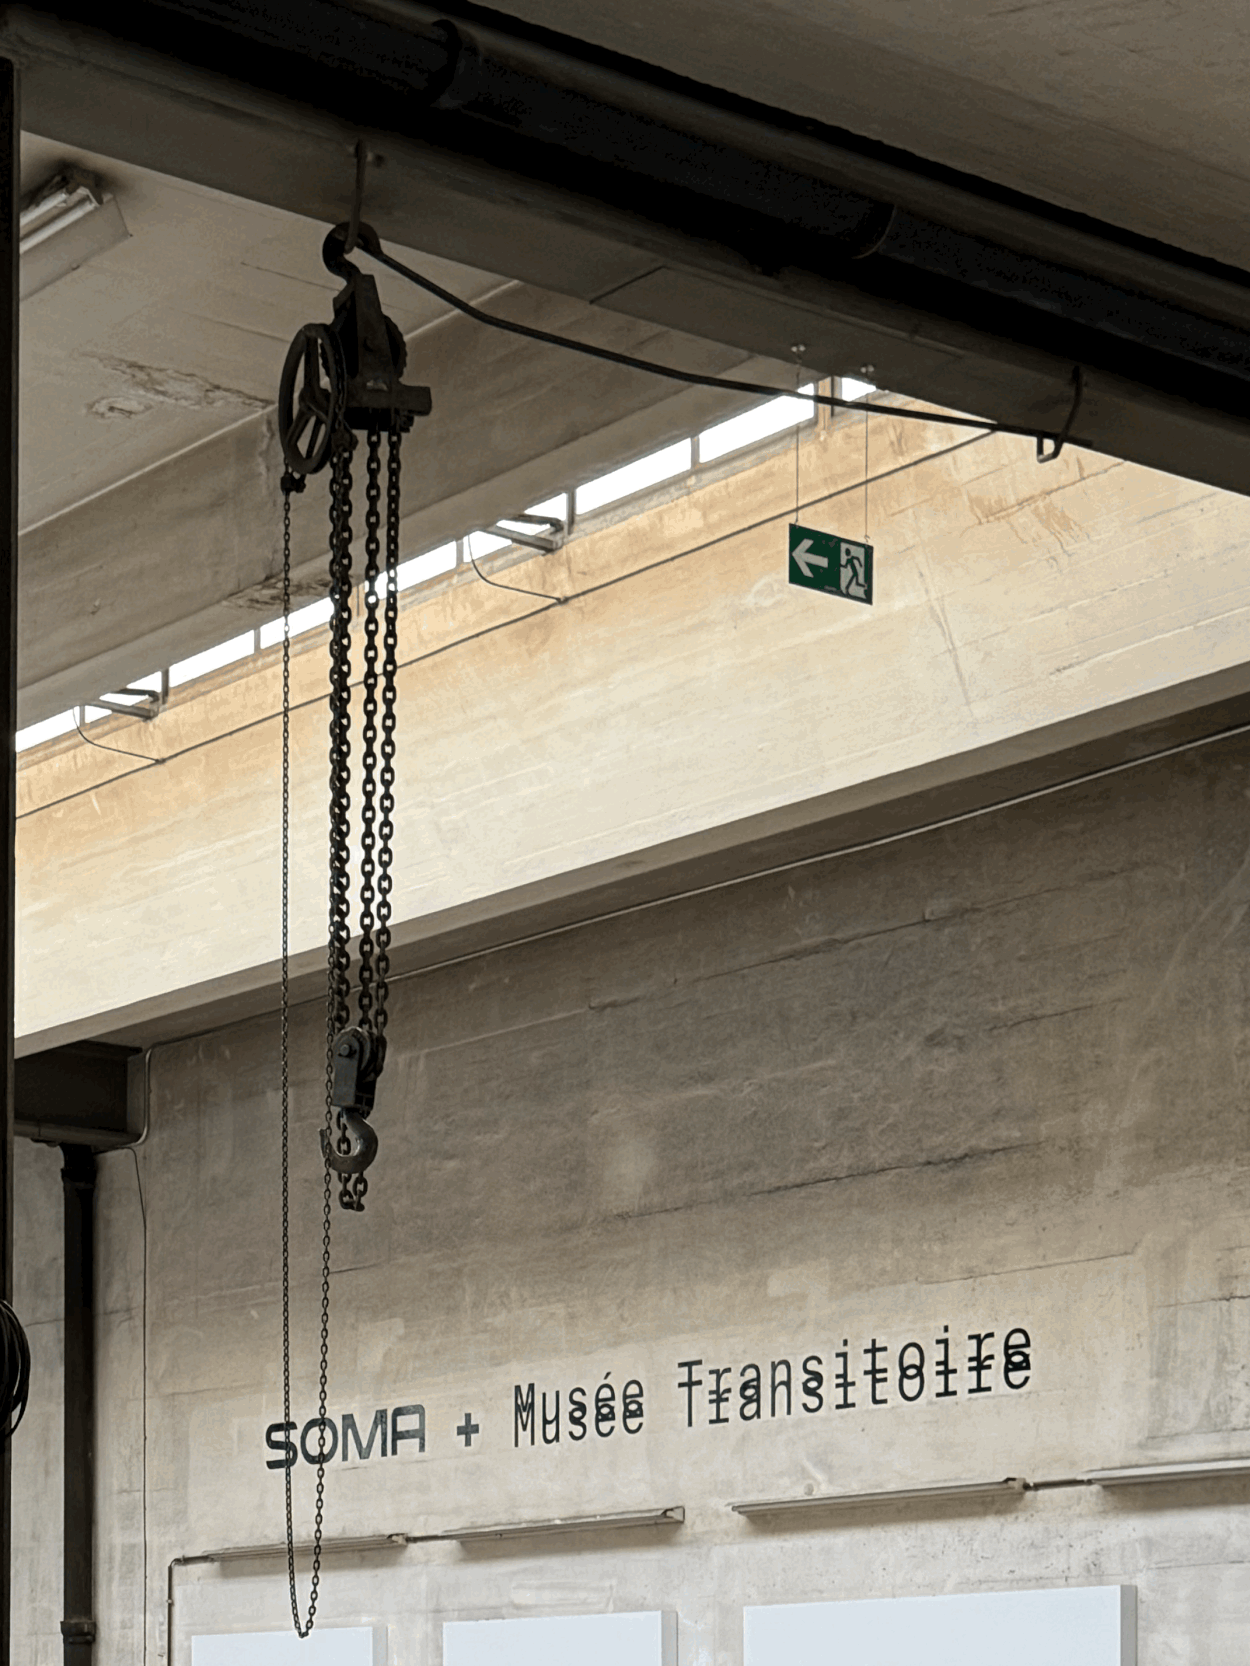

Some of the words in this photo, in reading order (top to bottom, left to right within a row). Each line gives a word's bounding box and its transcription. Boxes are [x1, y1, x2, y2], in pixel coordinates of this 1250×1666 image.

[265, 1404, 426, 1470] SOMA
[456, 1412, 480, 1447] +
[514, 1371, 644, 1448] Musée
[677, 1325, 1032, 1428] Transitoire
